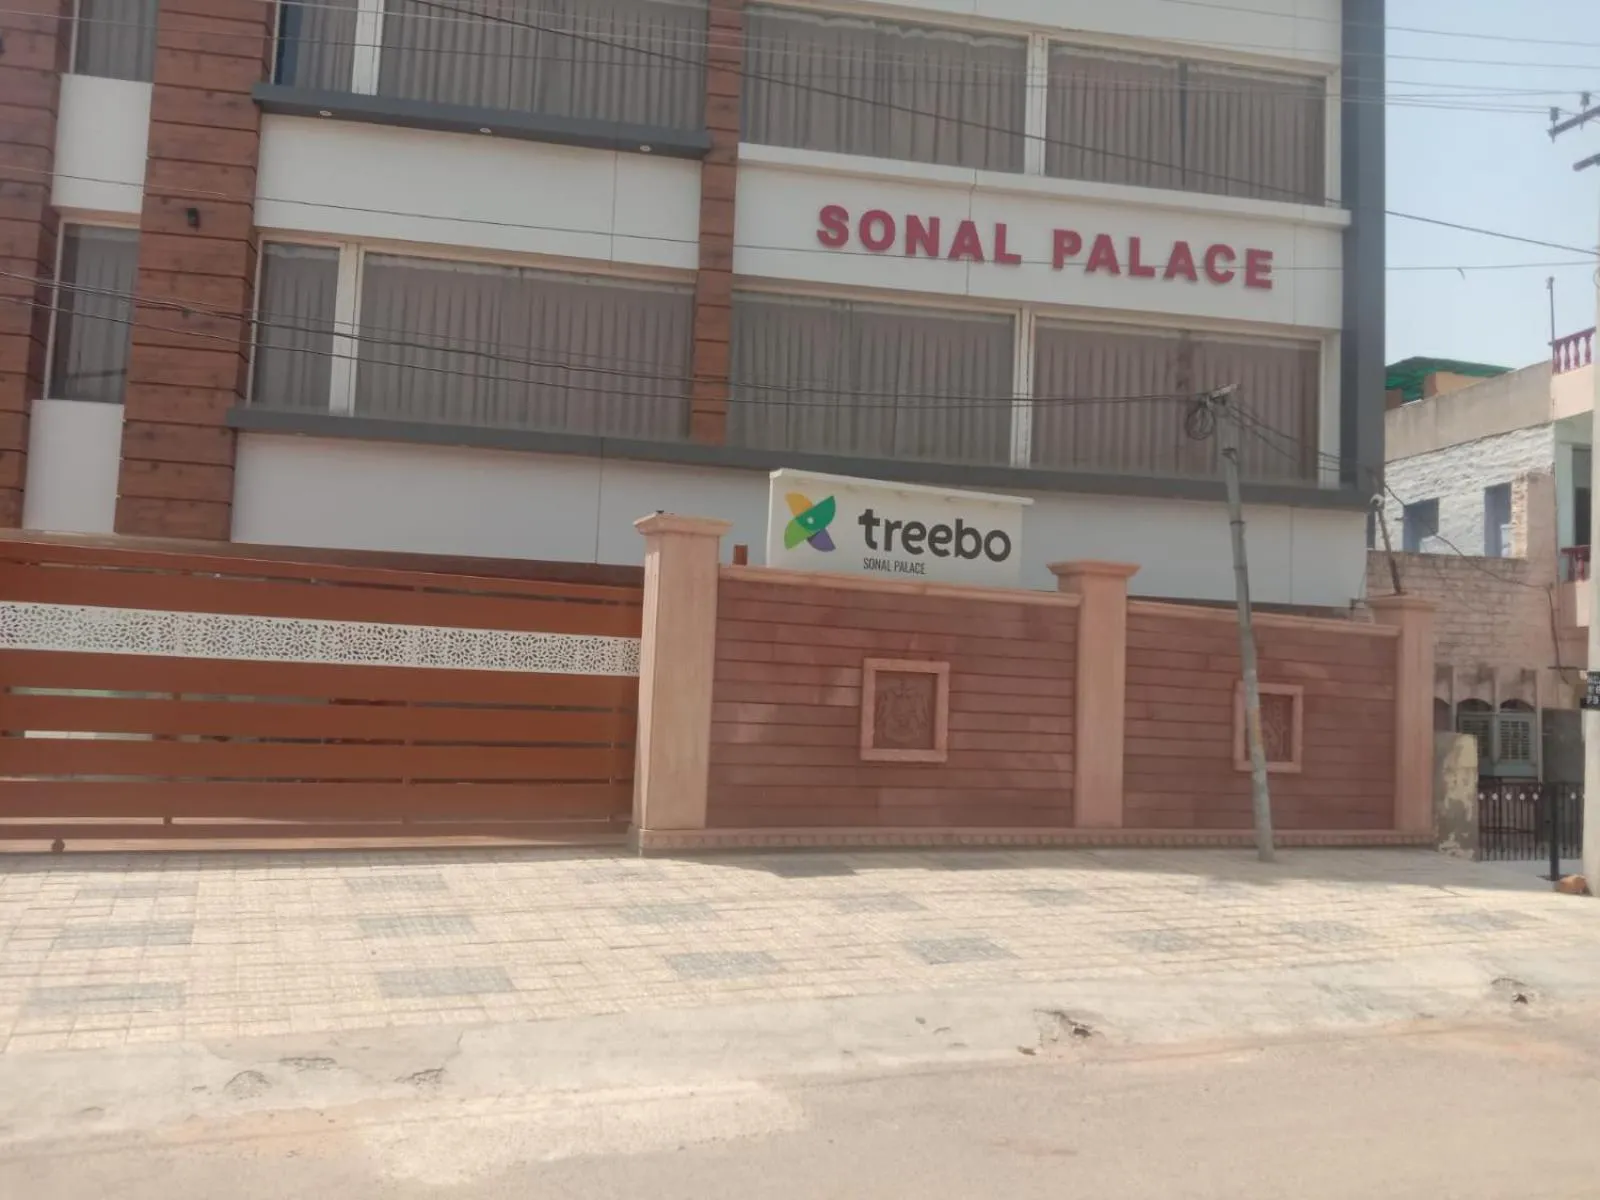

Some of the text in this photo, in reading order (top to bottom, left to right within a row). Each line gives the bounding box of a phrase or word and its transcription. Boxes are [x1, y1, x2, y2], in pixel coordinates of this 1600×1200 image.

[816, 204, 1274, 289] SONAL PALACE
[858, 509, 1012, 563] treebo
[863, 557, 926, 575] SONAL PALACE
